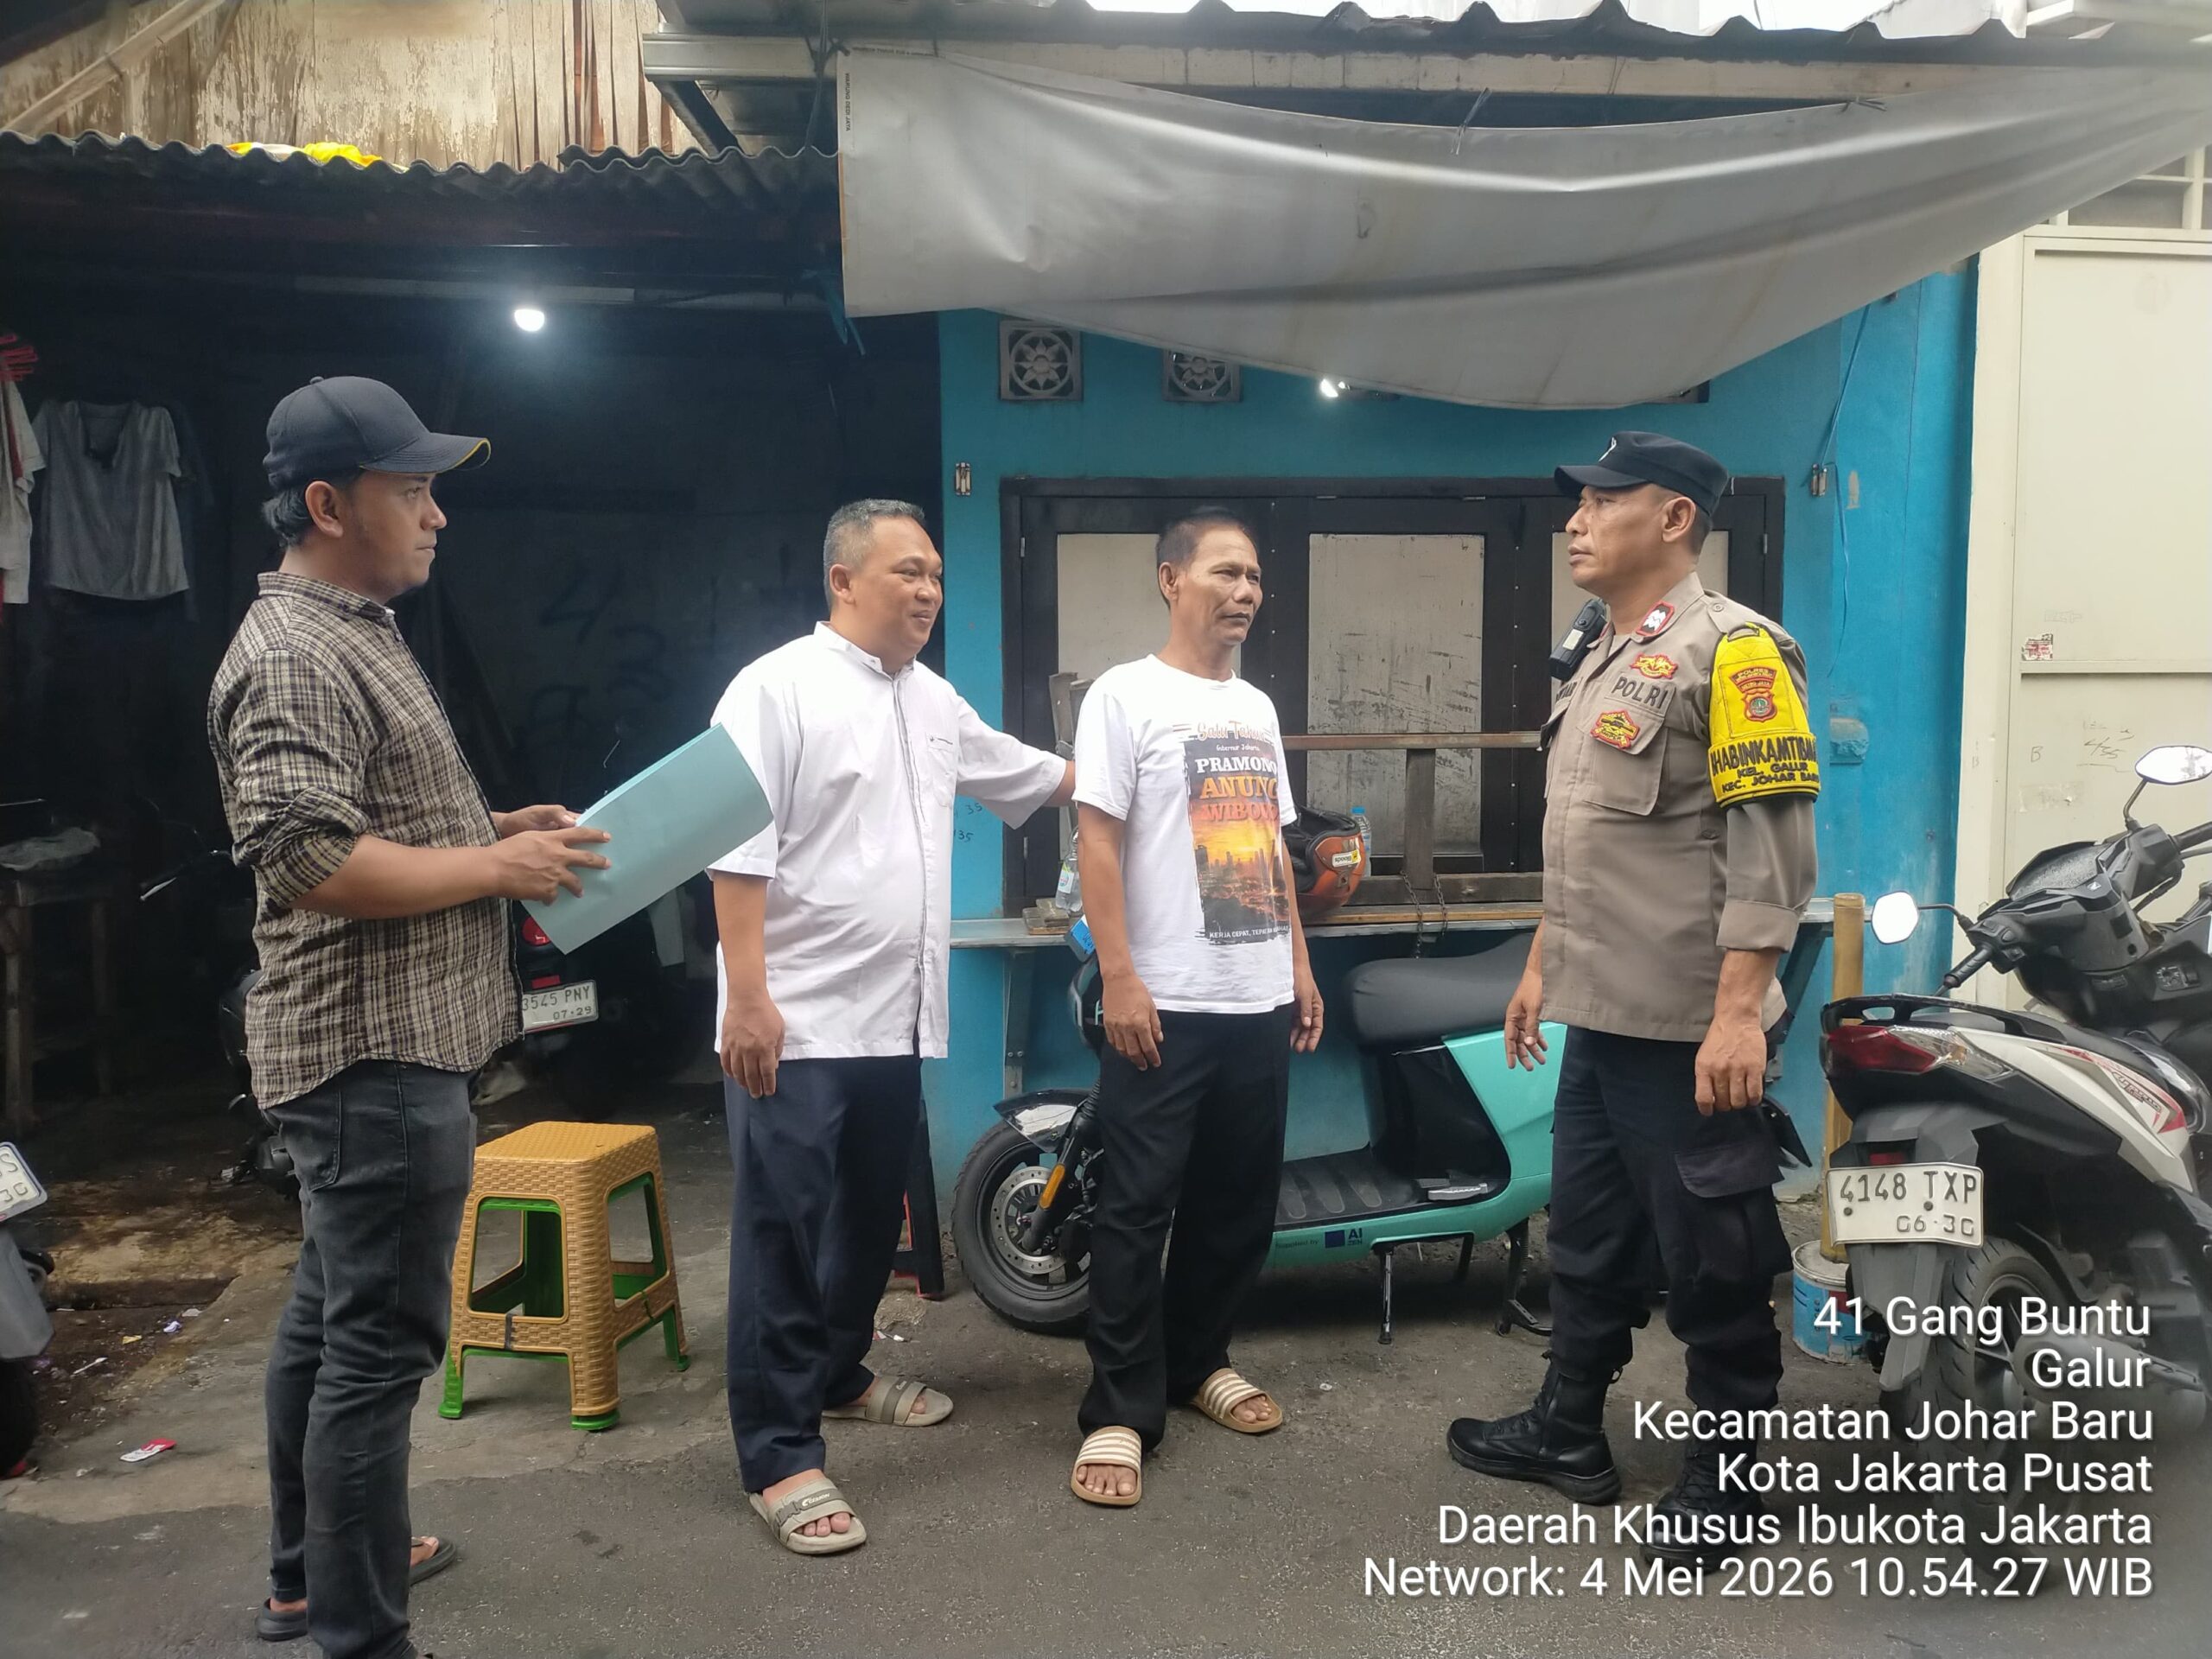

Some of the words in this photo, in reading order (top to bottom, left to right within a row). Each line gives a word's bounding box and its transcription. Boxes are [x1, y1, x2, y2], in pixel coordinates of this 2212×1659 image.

[1611, 676, 1669, 709] POLRI
[1770, 761, 1808, 773] GALUR
[1722, 779, 1746, 792] KEC.
[1751, 772, 1796, 786] JOHAR
[1210, 931, 1231, 939] KERJA
[564, 986, 590, 1002] PNY
[1840, 1173, 1907, 1202] 4148
[1923, 1171, 1977, 1204] TXP
[1348, 1227, 1363, 1239] AI
